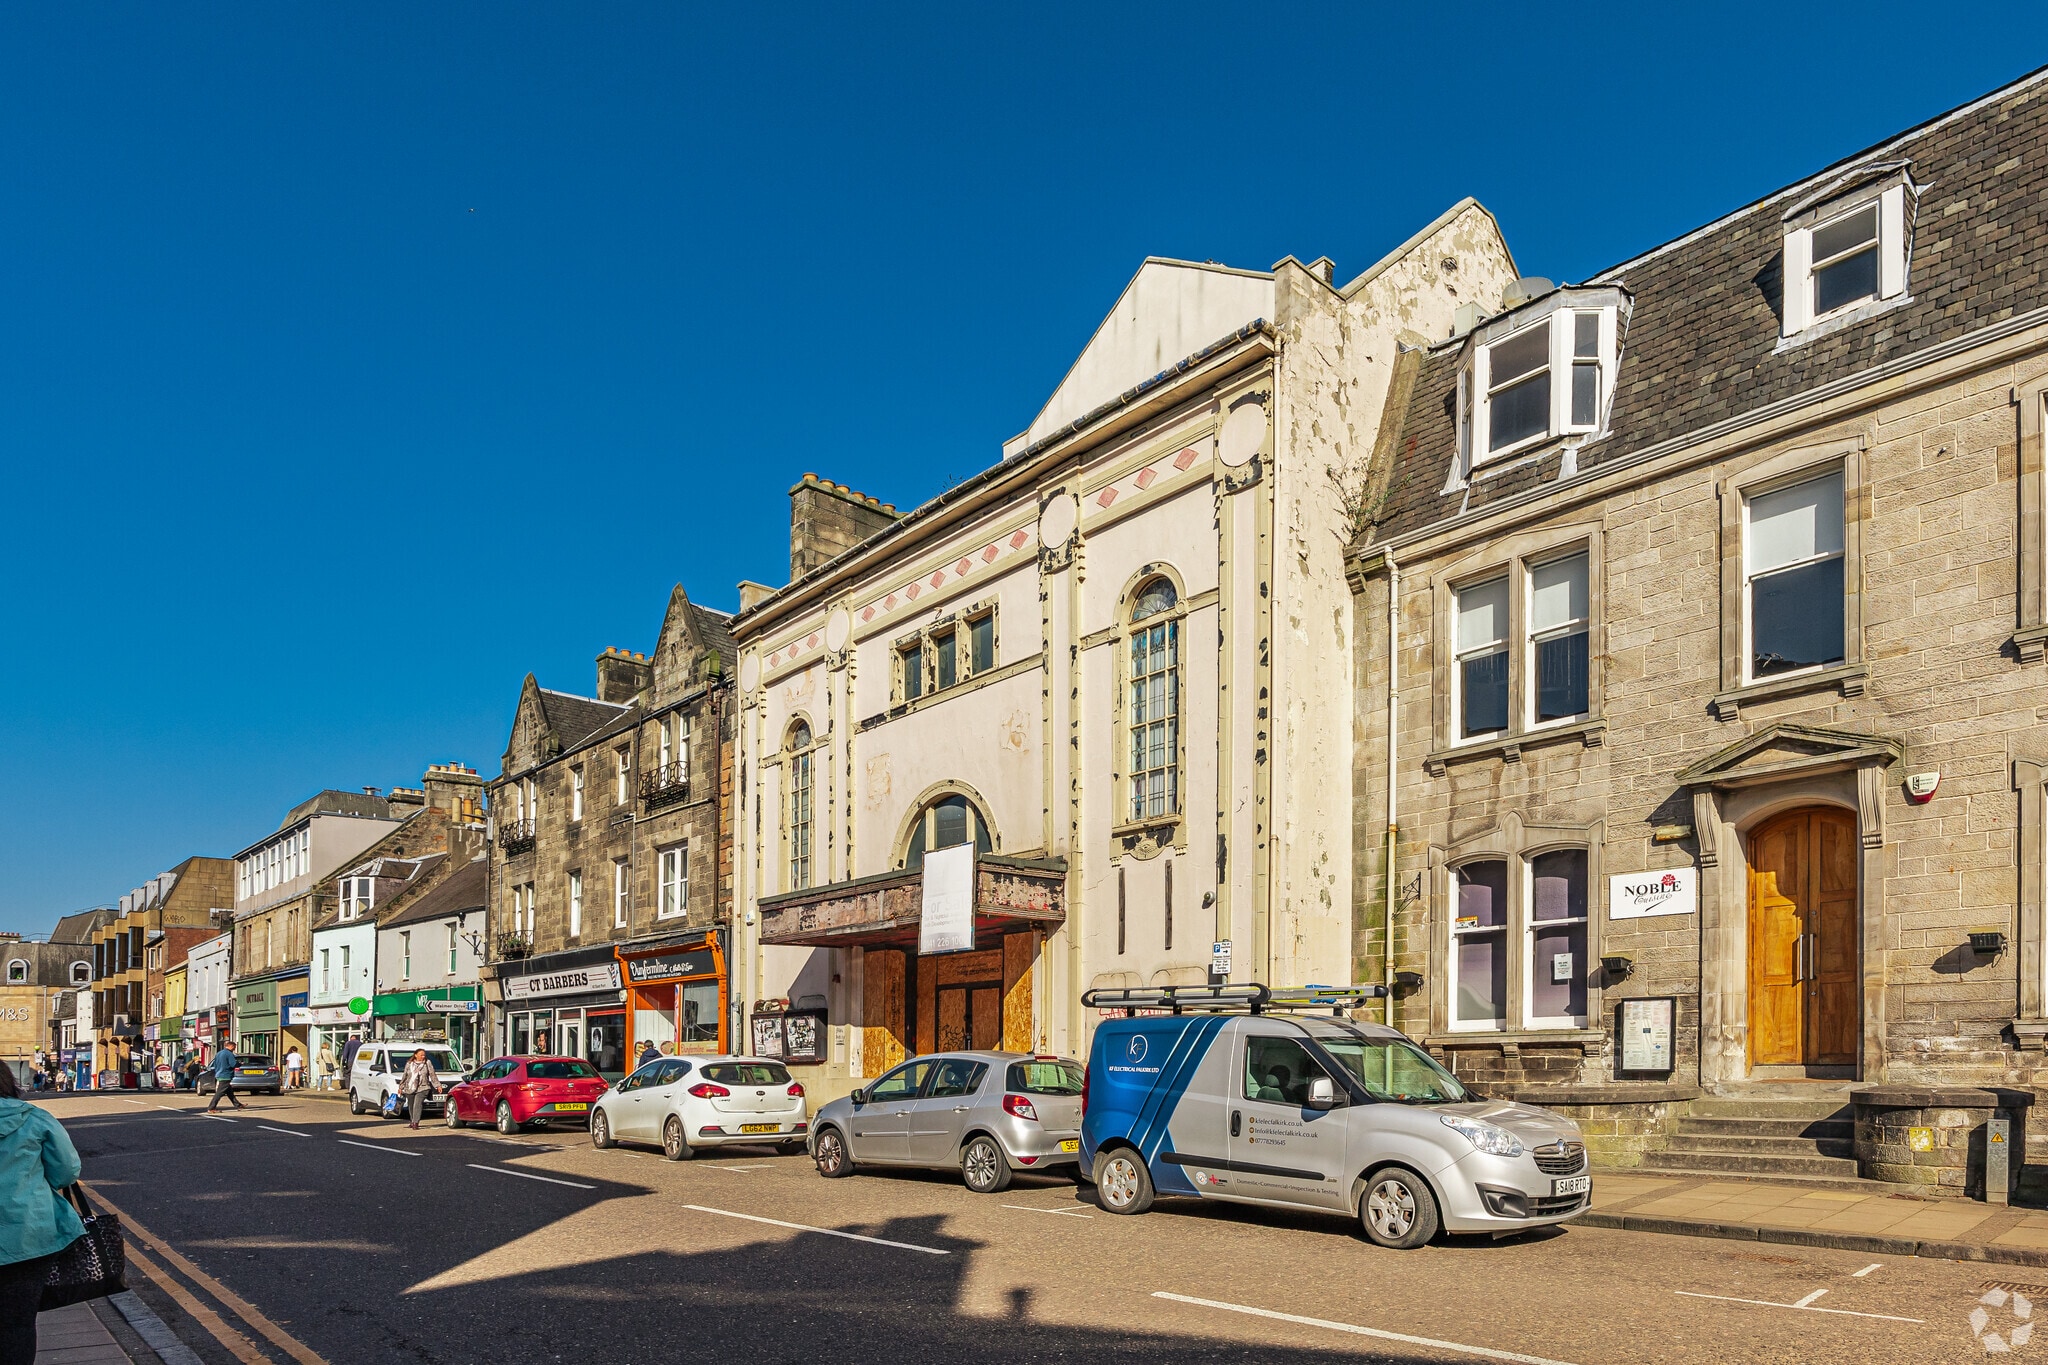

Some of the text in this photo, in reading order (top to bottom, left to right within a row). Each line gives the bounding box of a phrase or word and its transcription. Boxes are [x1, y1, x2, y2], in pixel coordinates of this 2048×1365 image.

[1624, 880, 1682, 897] NOBLE
[936, 936, 950, 947] 226
[630, 959, 668, 980] Dunfermline
[529, 972, 589, 992] CT BARBERS
[1321, 1189, 1339, 1197] Testing
